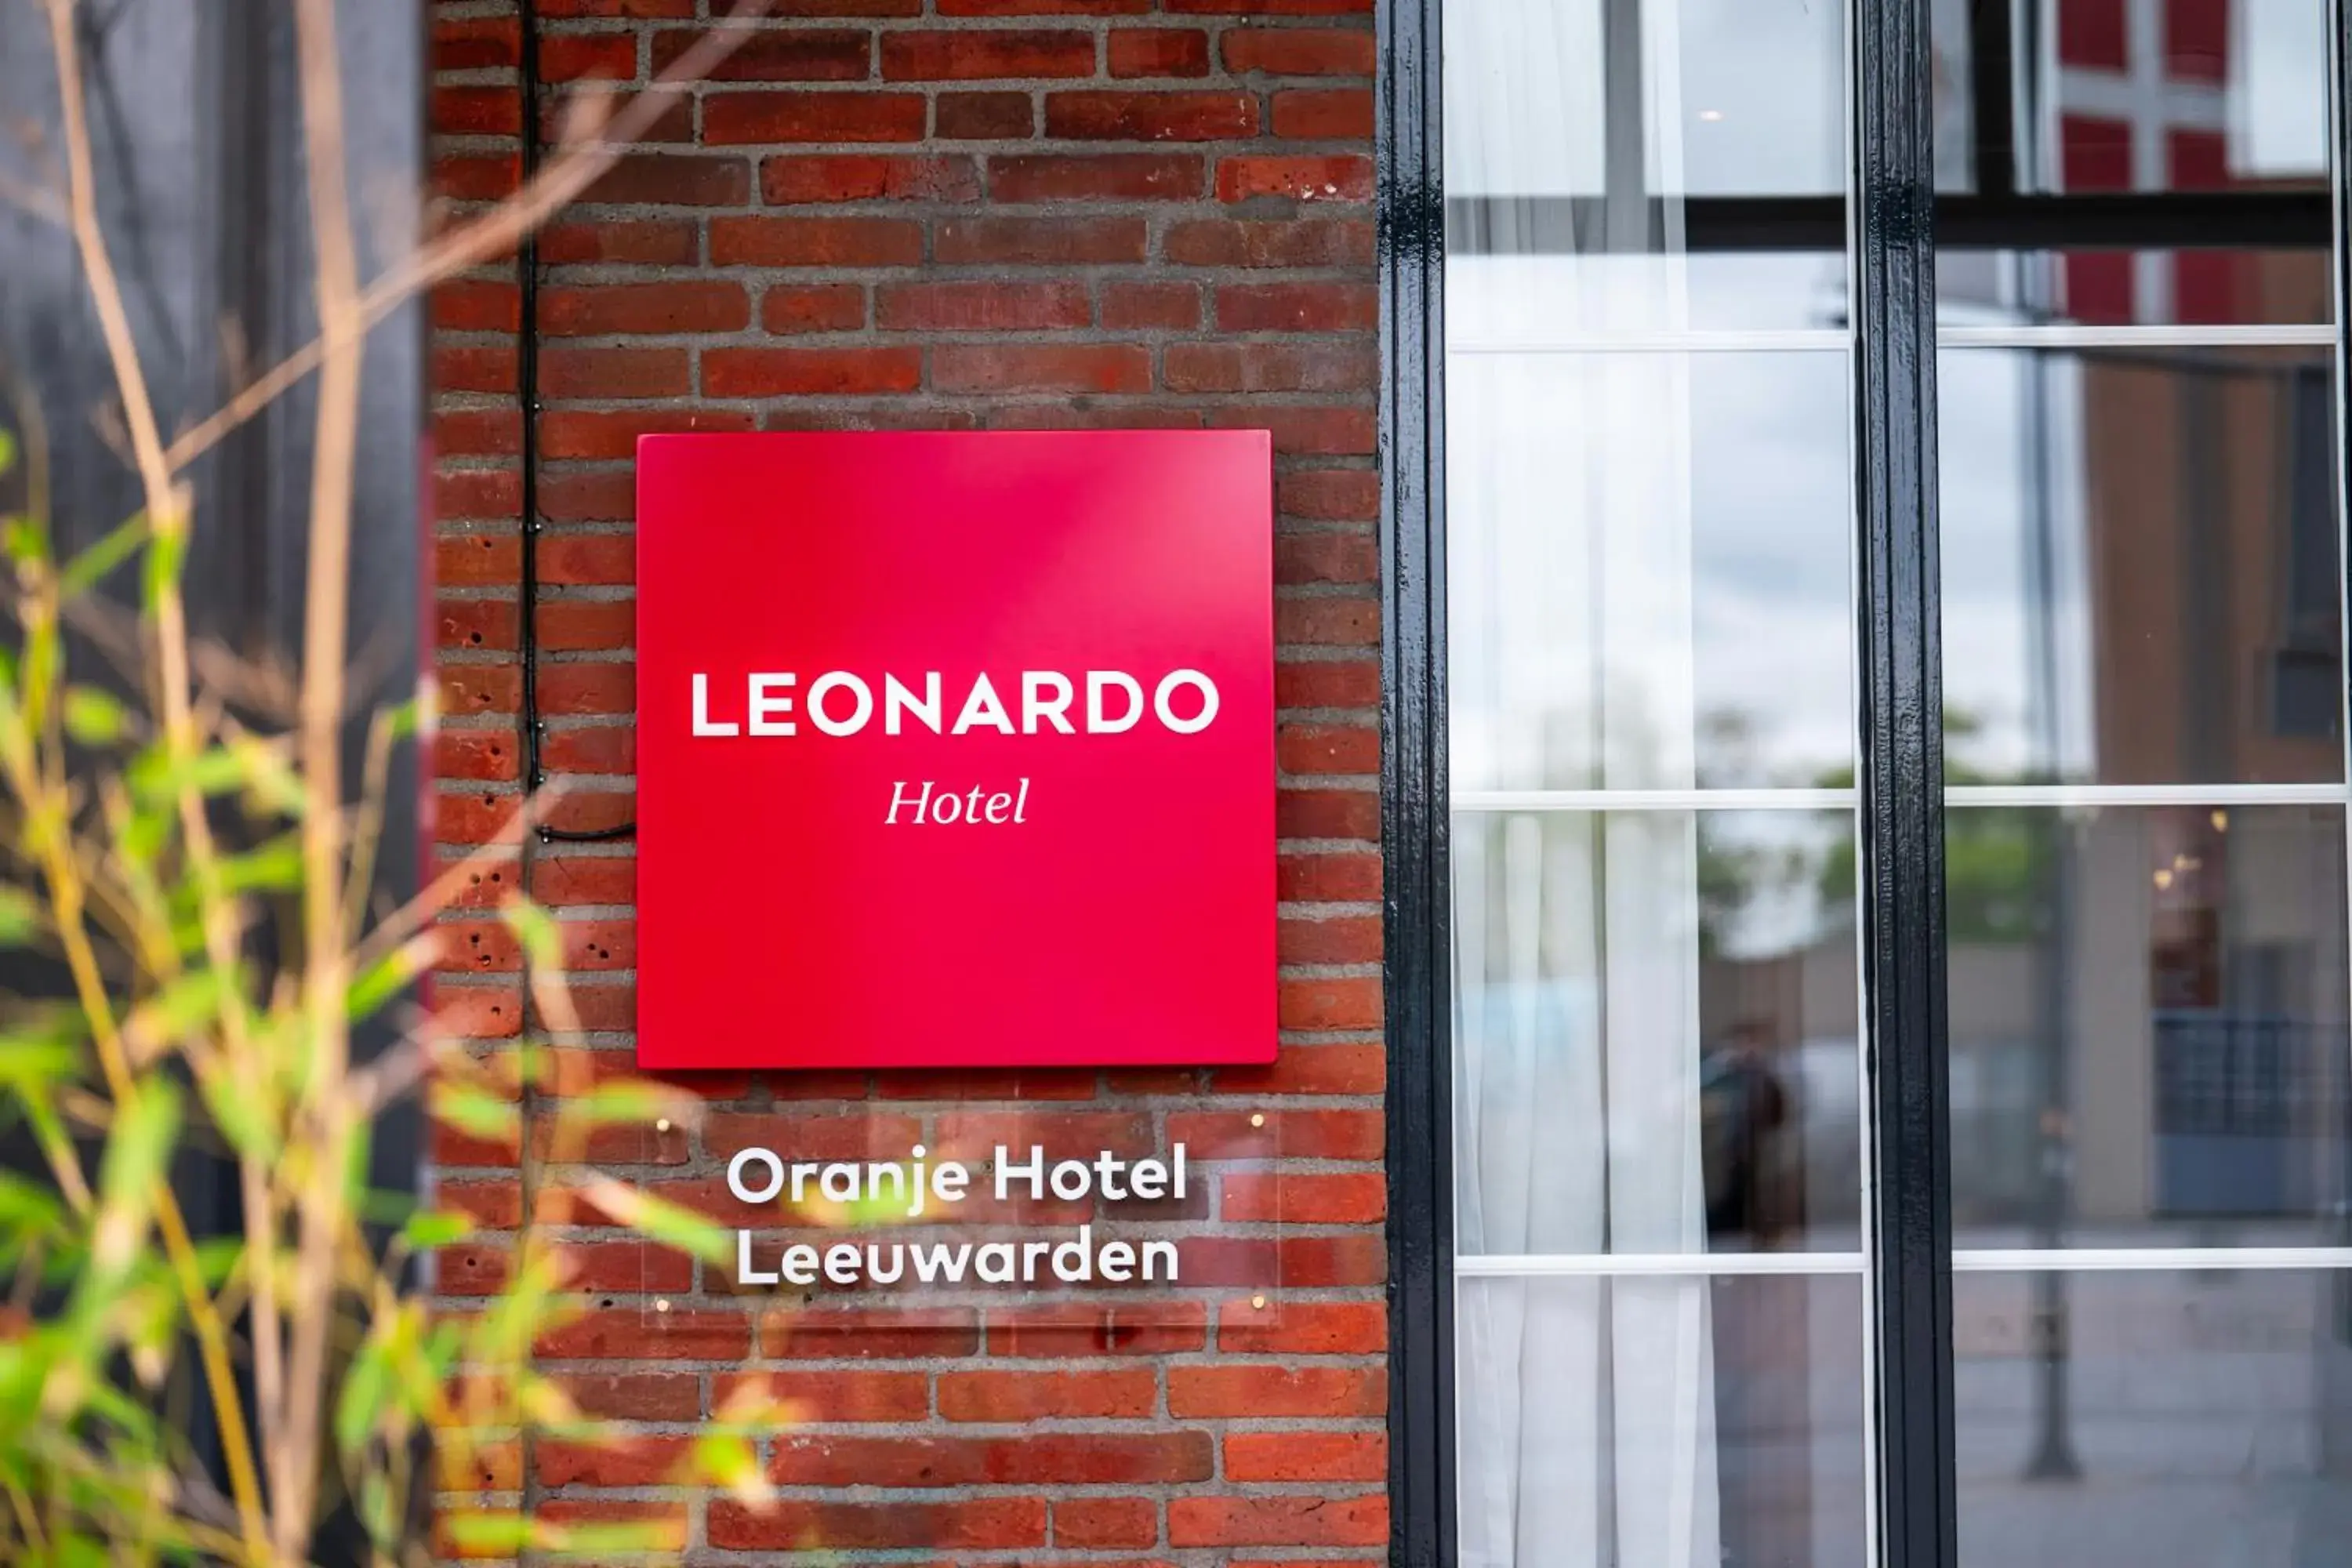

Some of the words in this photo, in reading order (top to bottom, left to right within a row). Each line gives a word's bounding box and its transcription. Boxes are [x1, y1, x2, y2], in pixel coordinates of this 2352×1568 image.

[691, 669, 1220, 737] LEONARDO
[884, 777, 1030, 824] Hotel
[726, 1145, 970, 1217] Oranje
[994, 1142, 1186, 1201] Hotel
[737, 1224, 1179, 1284] Leeuwarden
